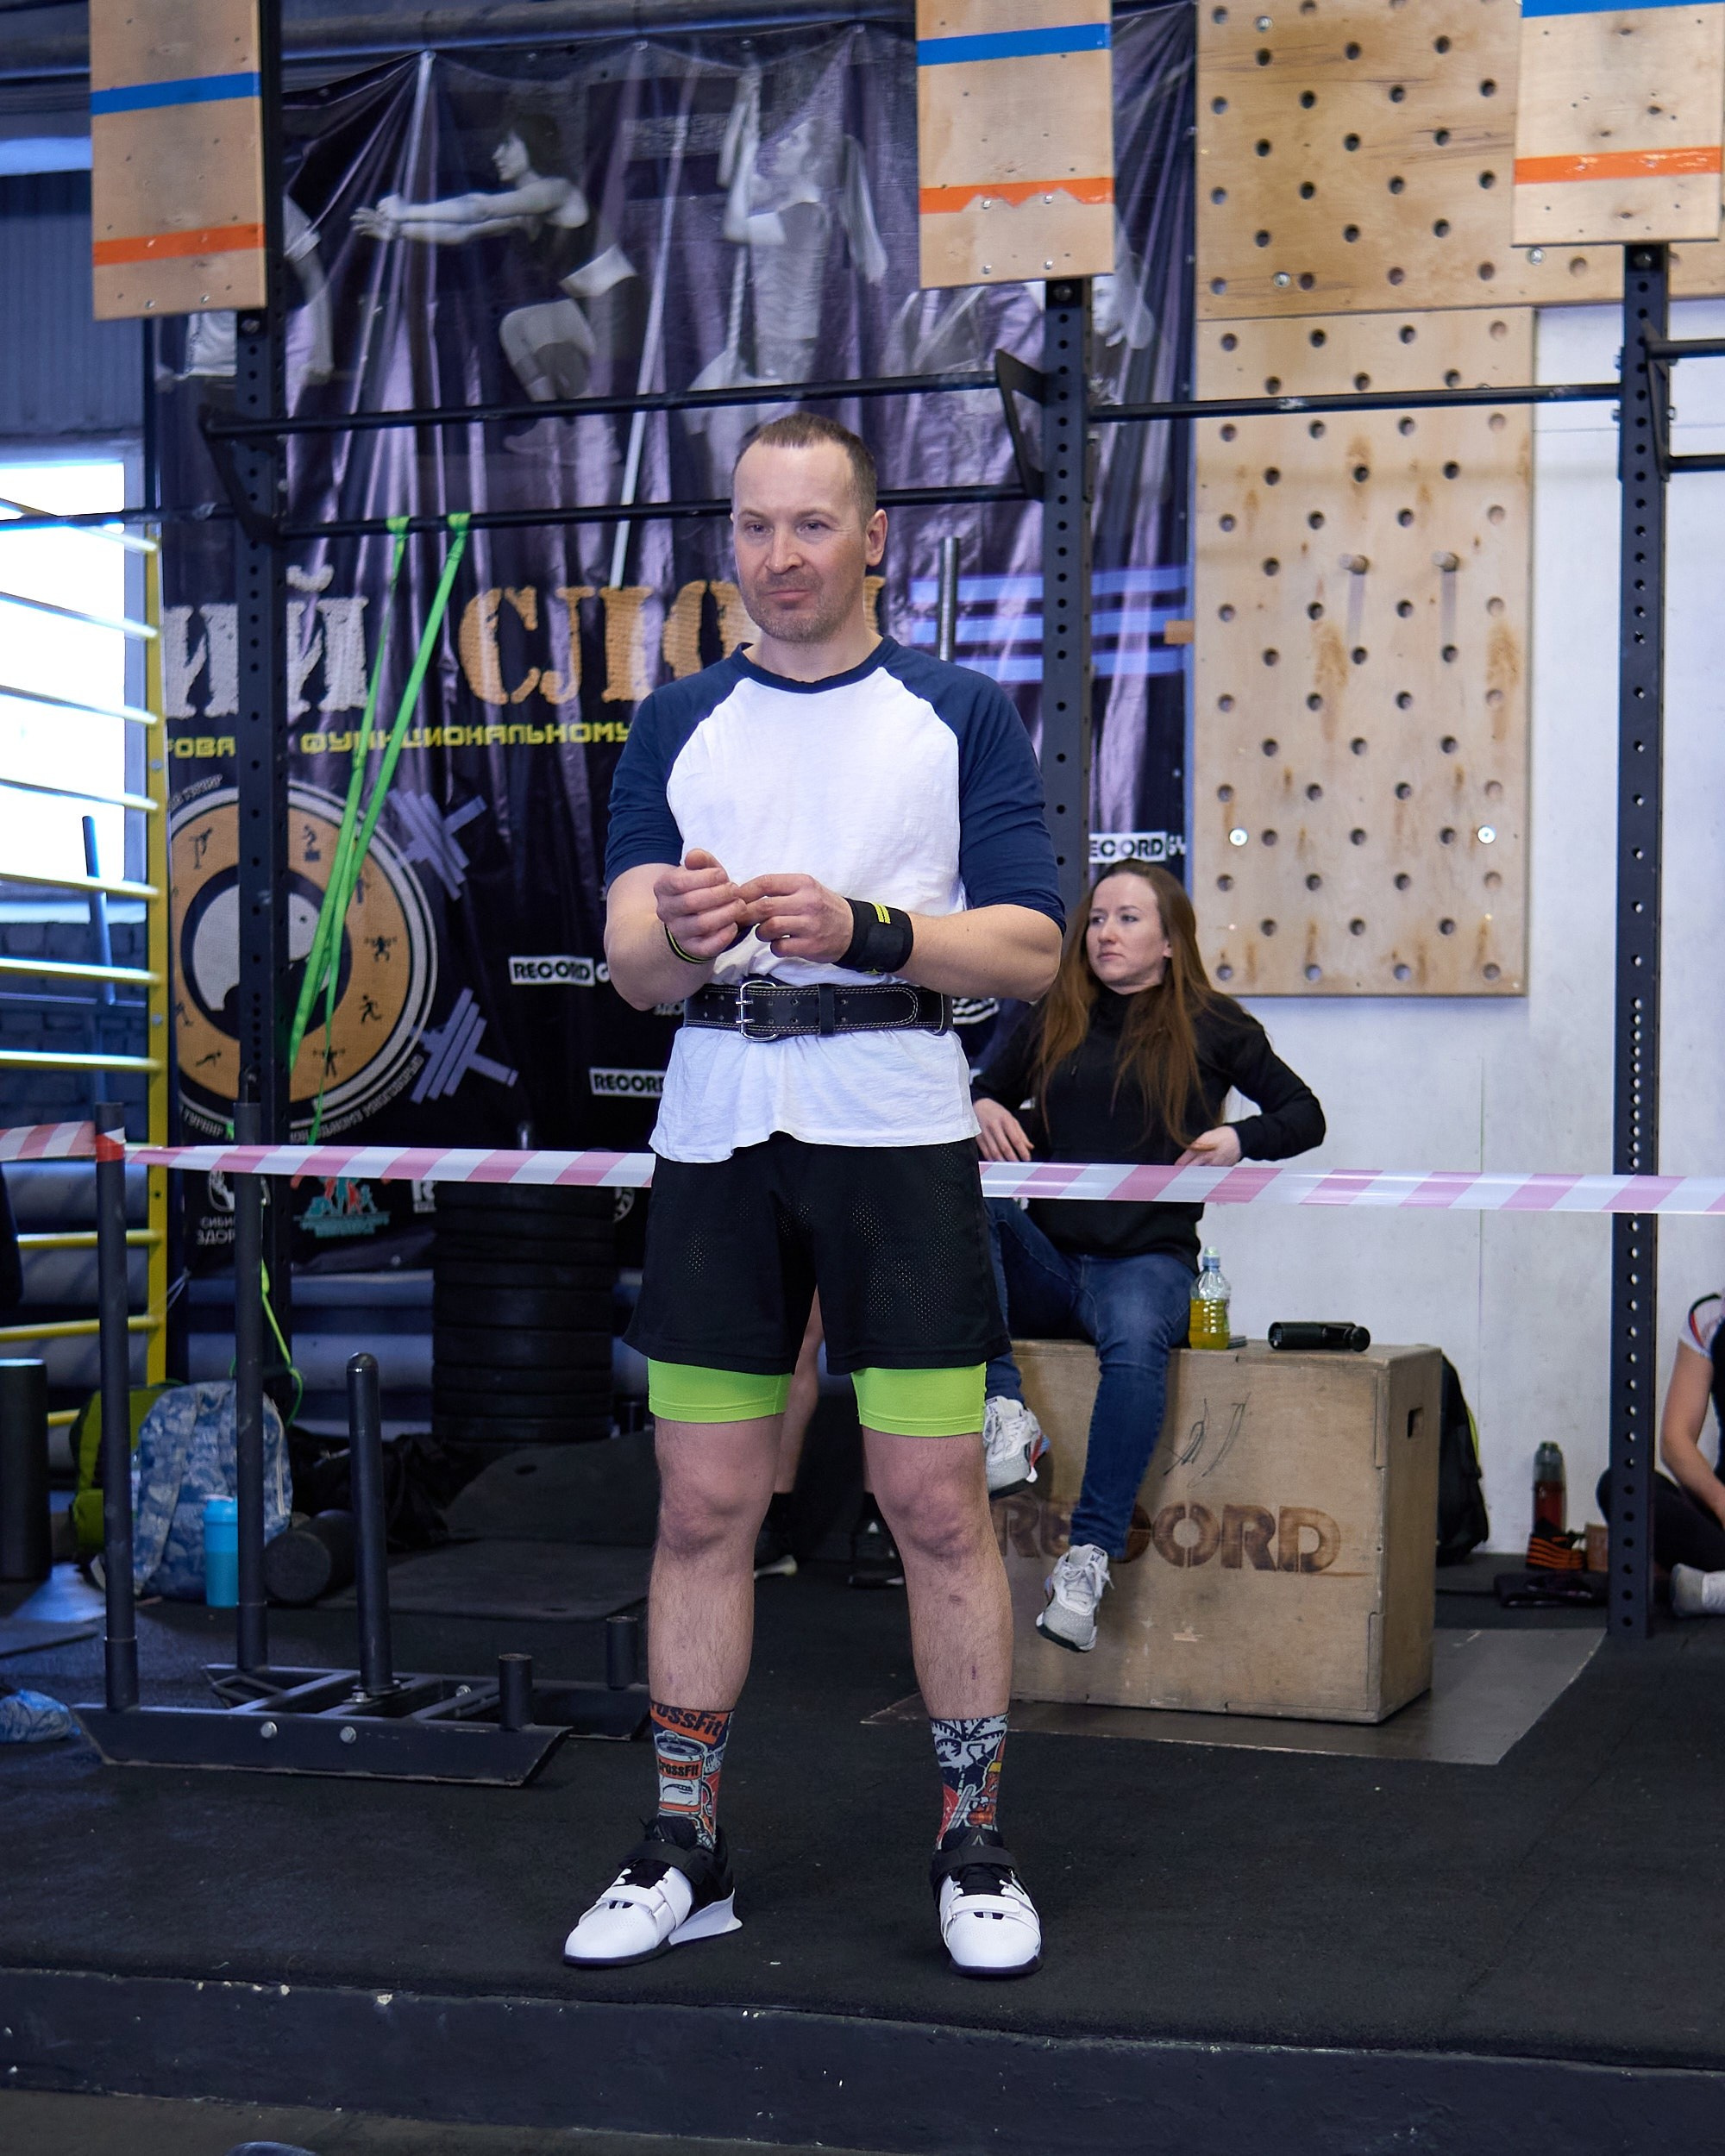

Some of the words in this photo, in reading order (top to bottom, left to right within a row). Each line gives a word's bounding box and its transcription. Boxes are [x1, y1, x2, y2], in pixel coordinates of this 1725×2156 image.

[459, 575, 886, 705] СЛО
[167, 736, 235, 759] ОВА
[513, 961, 591, 981] RECORD
[652, 1704, 723, 1737] ossFit
